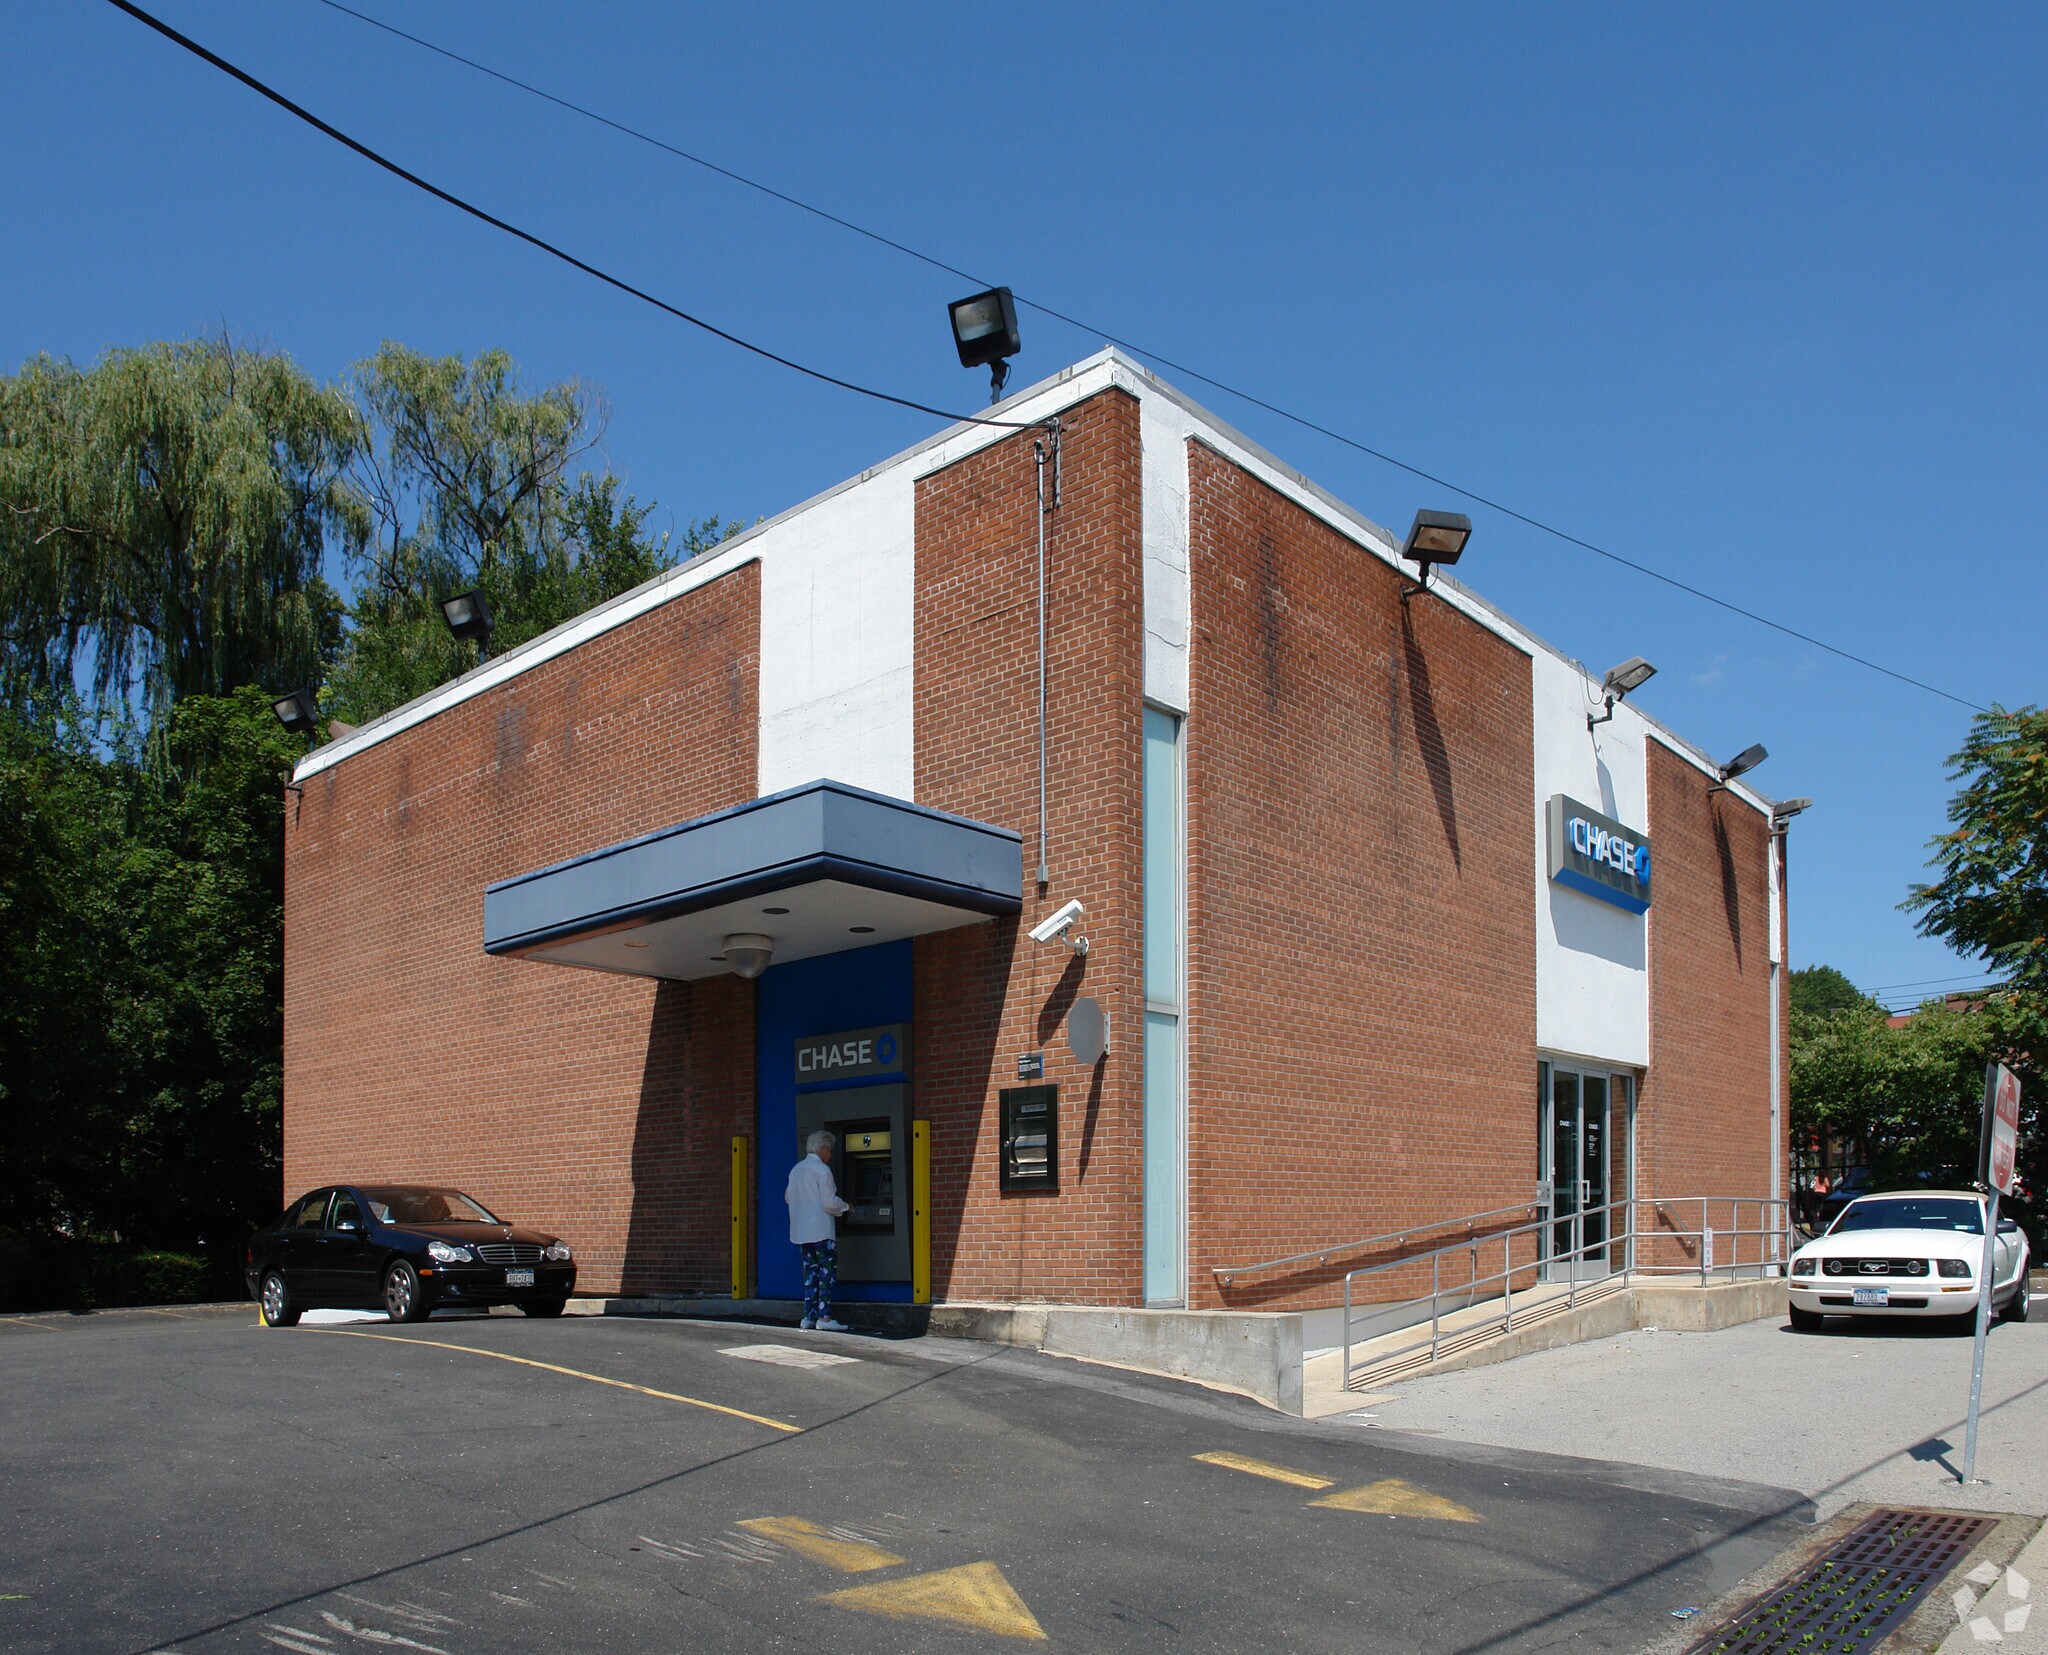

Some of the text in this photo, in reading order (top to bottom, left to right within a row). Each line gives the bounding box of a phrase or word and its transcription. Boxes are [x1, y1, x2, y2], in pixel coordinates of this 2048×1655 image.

[1569, 817, 1635, 876] CHASE
[798, 1039, 872, 1072] CHASE
[1999, 1091, 2015, 1119] DO NOT
[1996, 1145, 2009, 1169] ENTER
